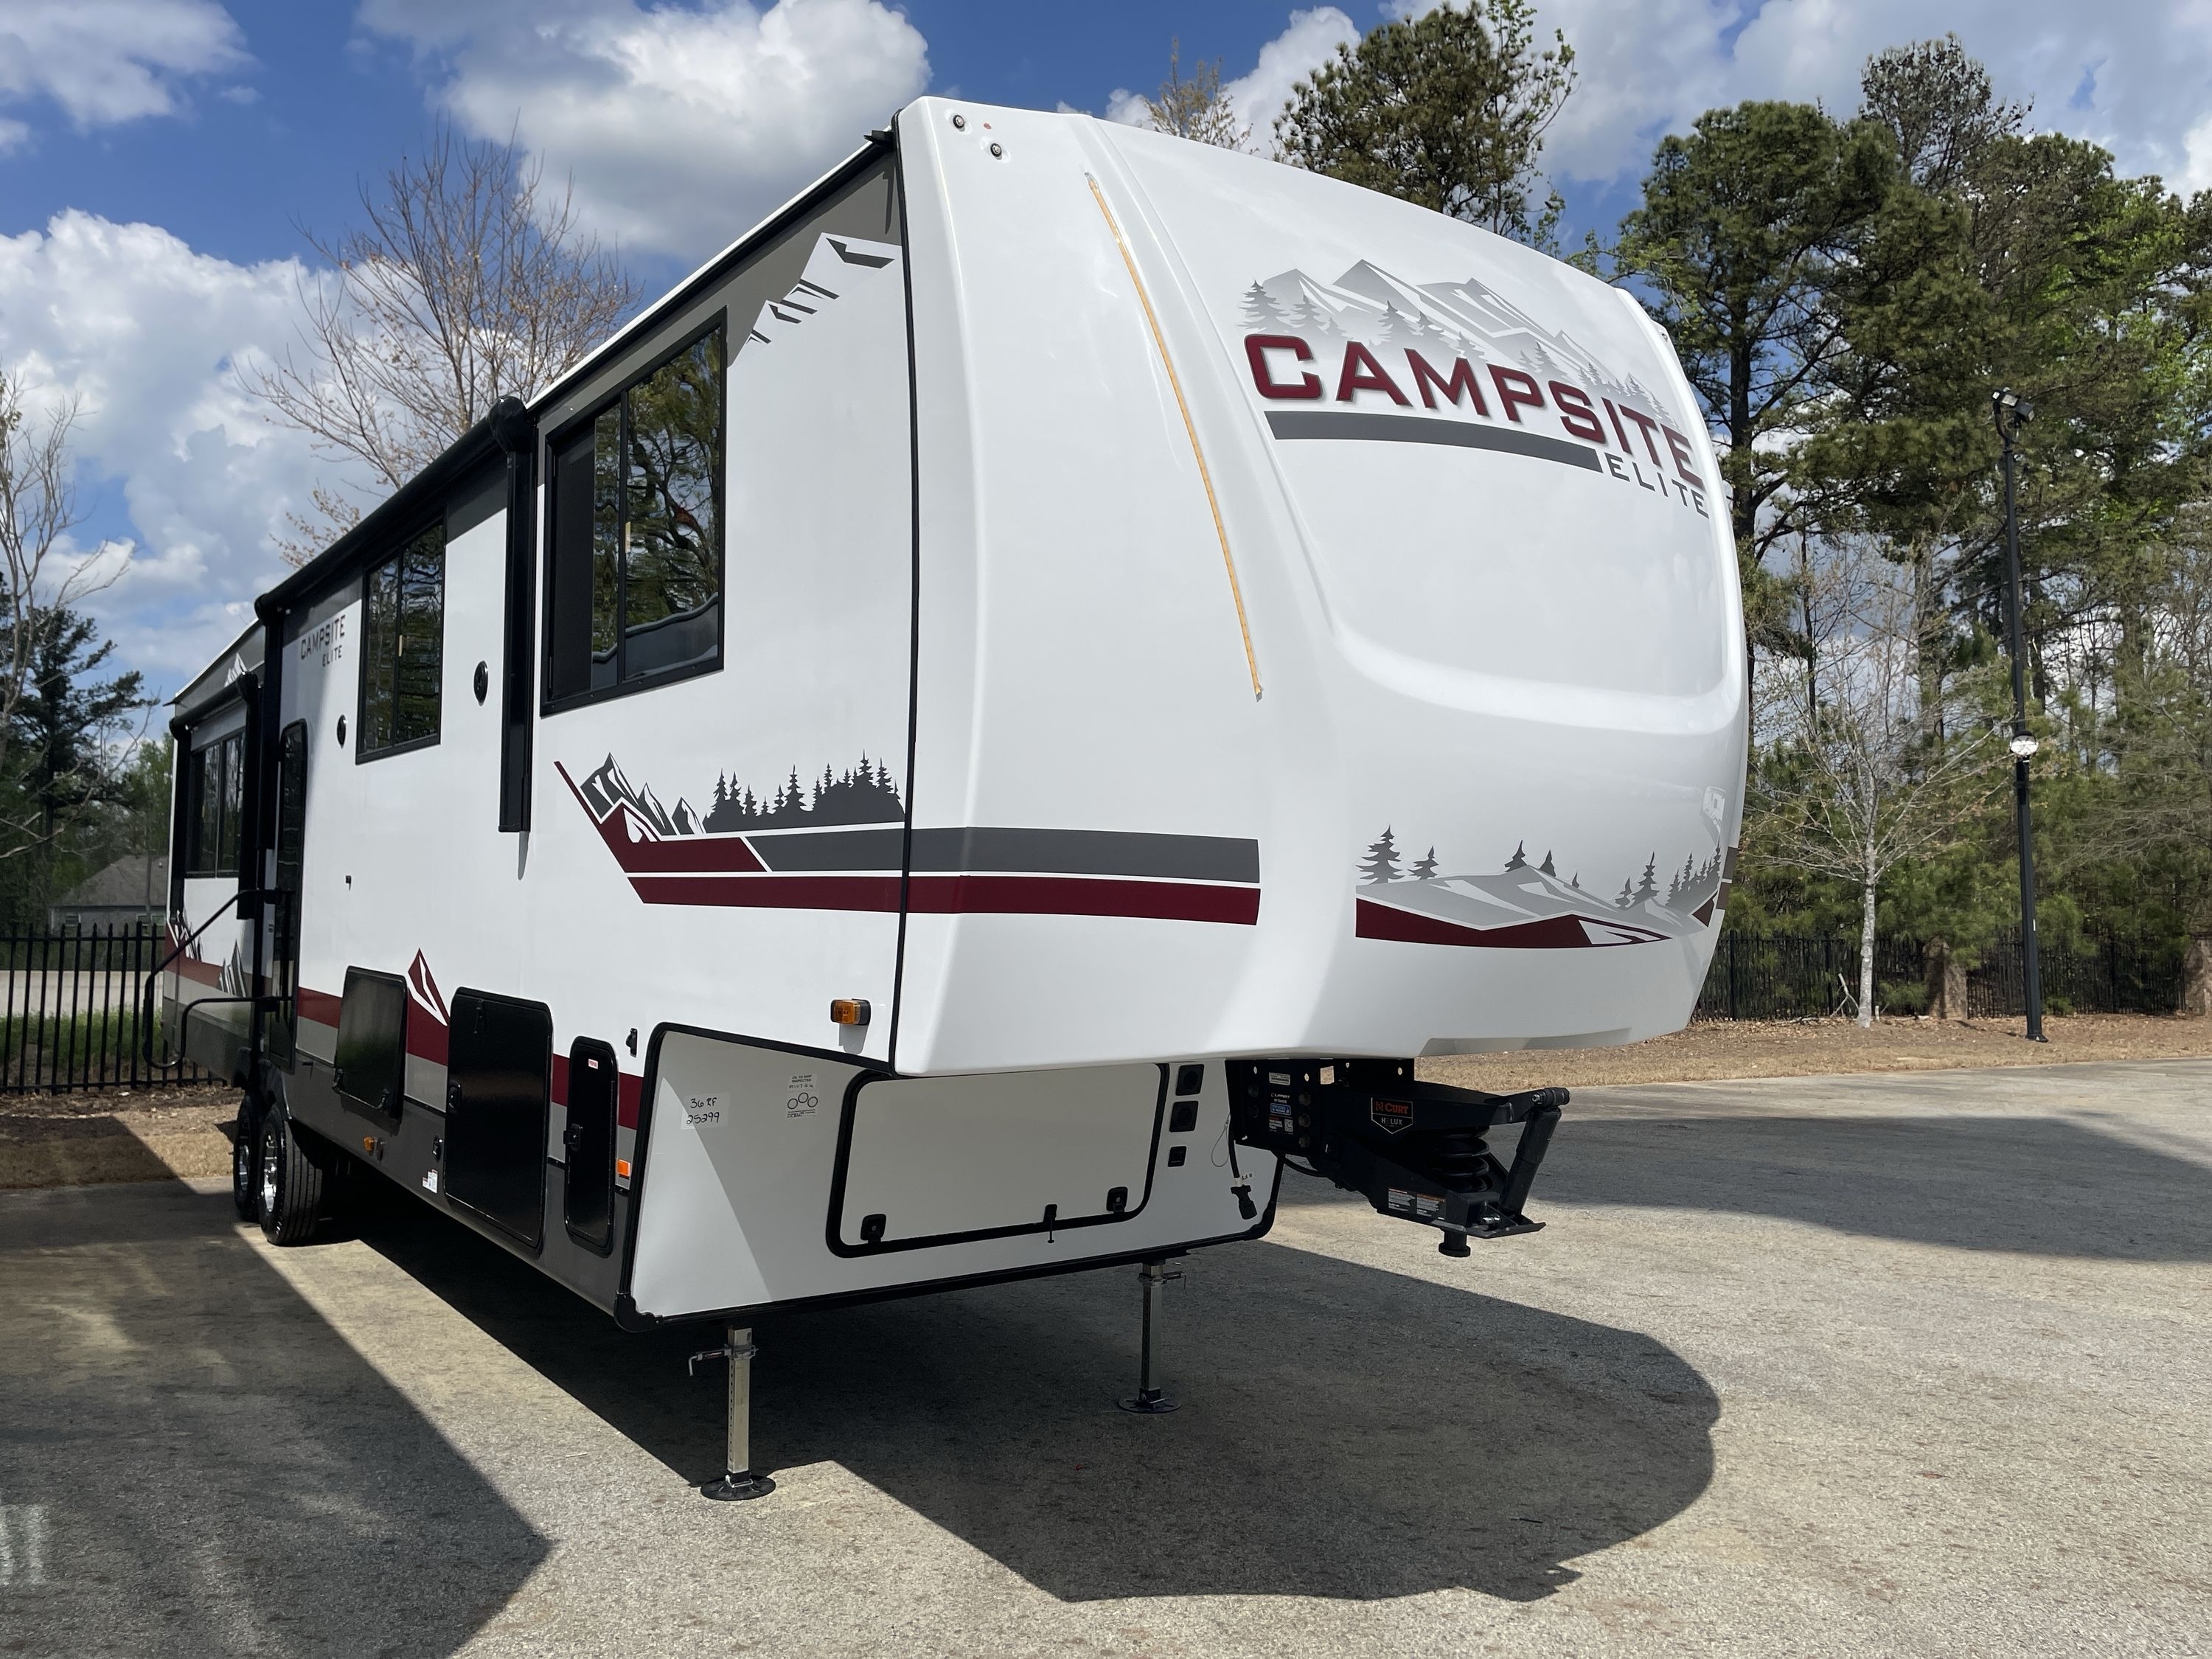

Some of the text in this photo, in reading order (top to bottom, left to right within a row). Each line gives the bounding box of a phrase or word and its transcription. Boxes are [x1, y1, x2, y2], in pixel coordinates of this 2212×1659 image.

[1244, 334, 1704, 490] CAMPSITE
[1603, 452, 1709, 519] ELITE
[300, 614, 346, 660] CAMPSITE
[322, 644, 342, 667] ELITE
[686, 1111, 720, 1125] 25299
[689, 1096, 718, 1109] 36 RF
